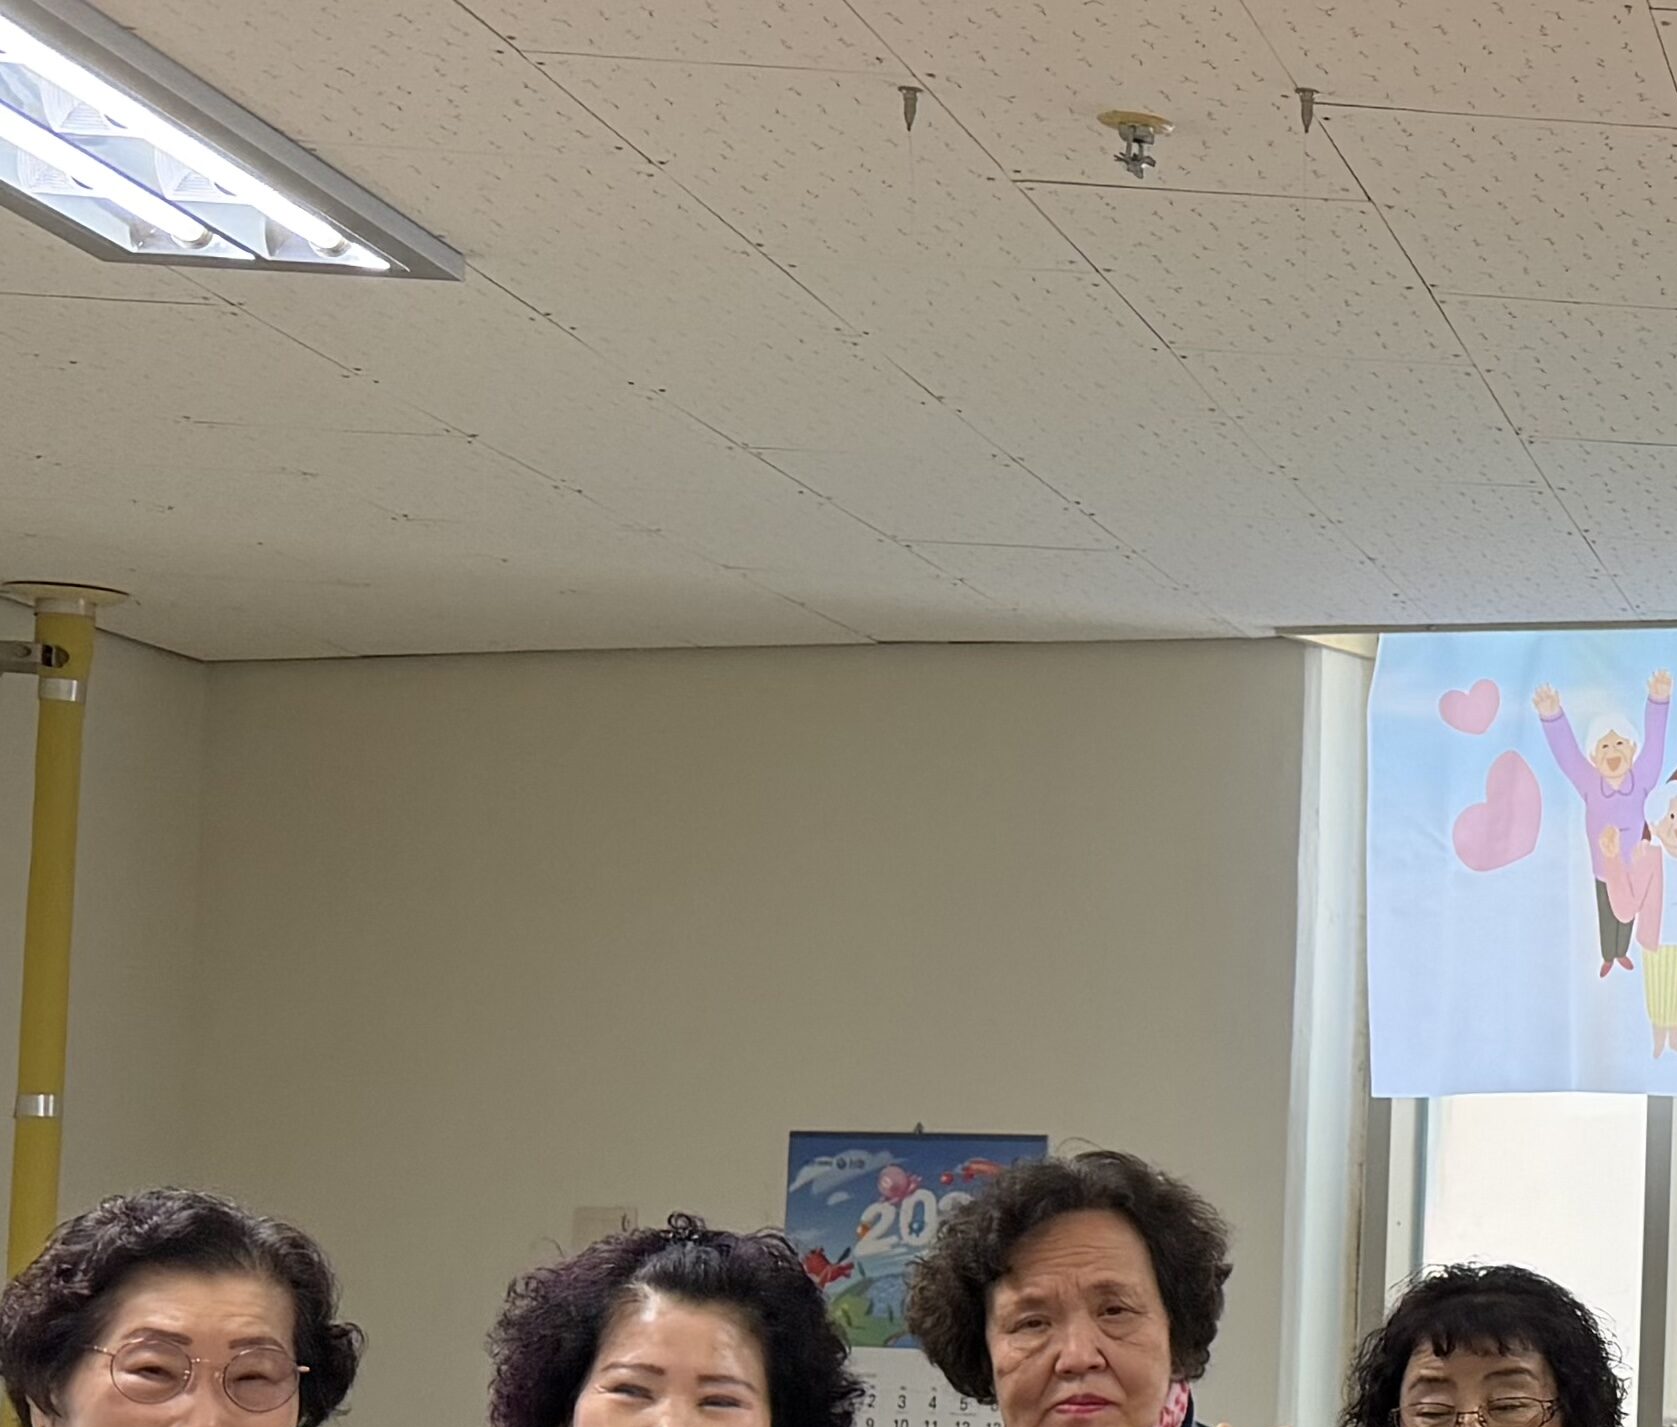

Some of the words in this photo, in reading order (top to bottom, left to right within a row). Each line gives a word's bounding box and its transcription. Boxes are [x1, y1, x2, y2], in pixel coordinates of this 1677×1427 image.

[898, 1395, 906, 1408] 3
[929, 1396, 937, 1409] 4
[960, 1398, 968, 1411] 5
